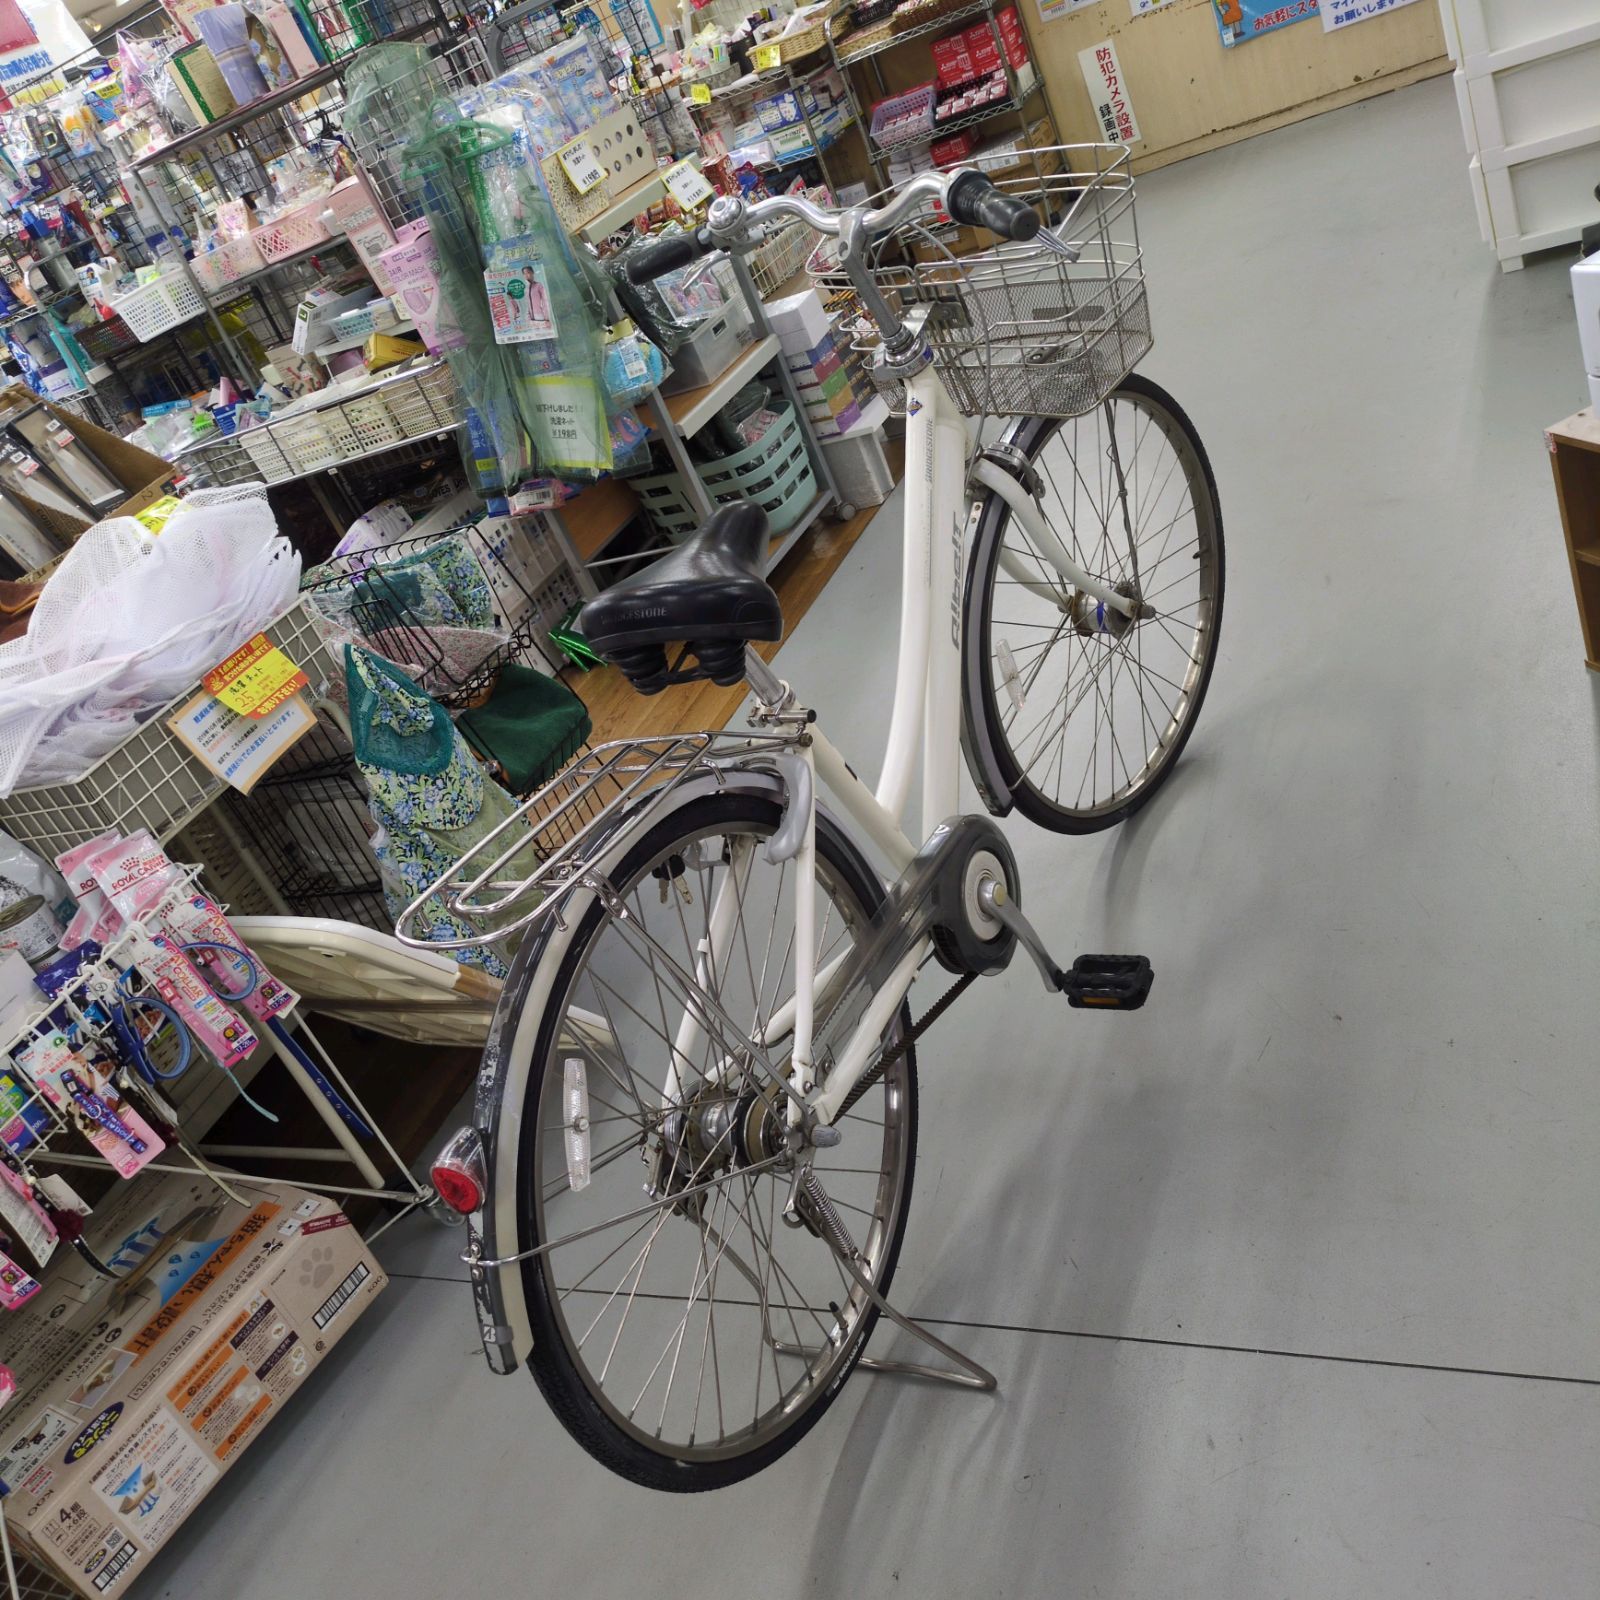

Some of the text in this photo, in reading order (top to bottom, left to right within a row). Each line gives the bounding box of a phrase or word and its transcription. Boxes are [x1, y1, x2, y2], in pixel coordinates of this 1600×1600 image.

[1331, 0, 1364, 11] マイ
[1095, 47, 1135, 140] 防犯カメラ設置
[1099, 103, 1119, 142] 録画中
[409, 264, 426, 276] MASK
[111, 871, 137, 890] ROYAL
[172, 966, 204, 998] COLLAR
[130, 1208, 268, 1356] 猫ちゃん想い設計
[72, 1410, 119, 1458] ニャンとも
